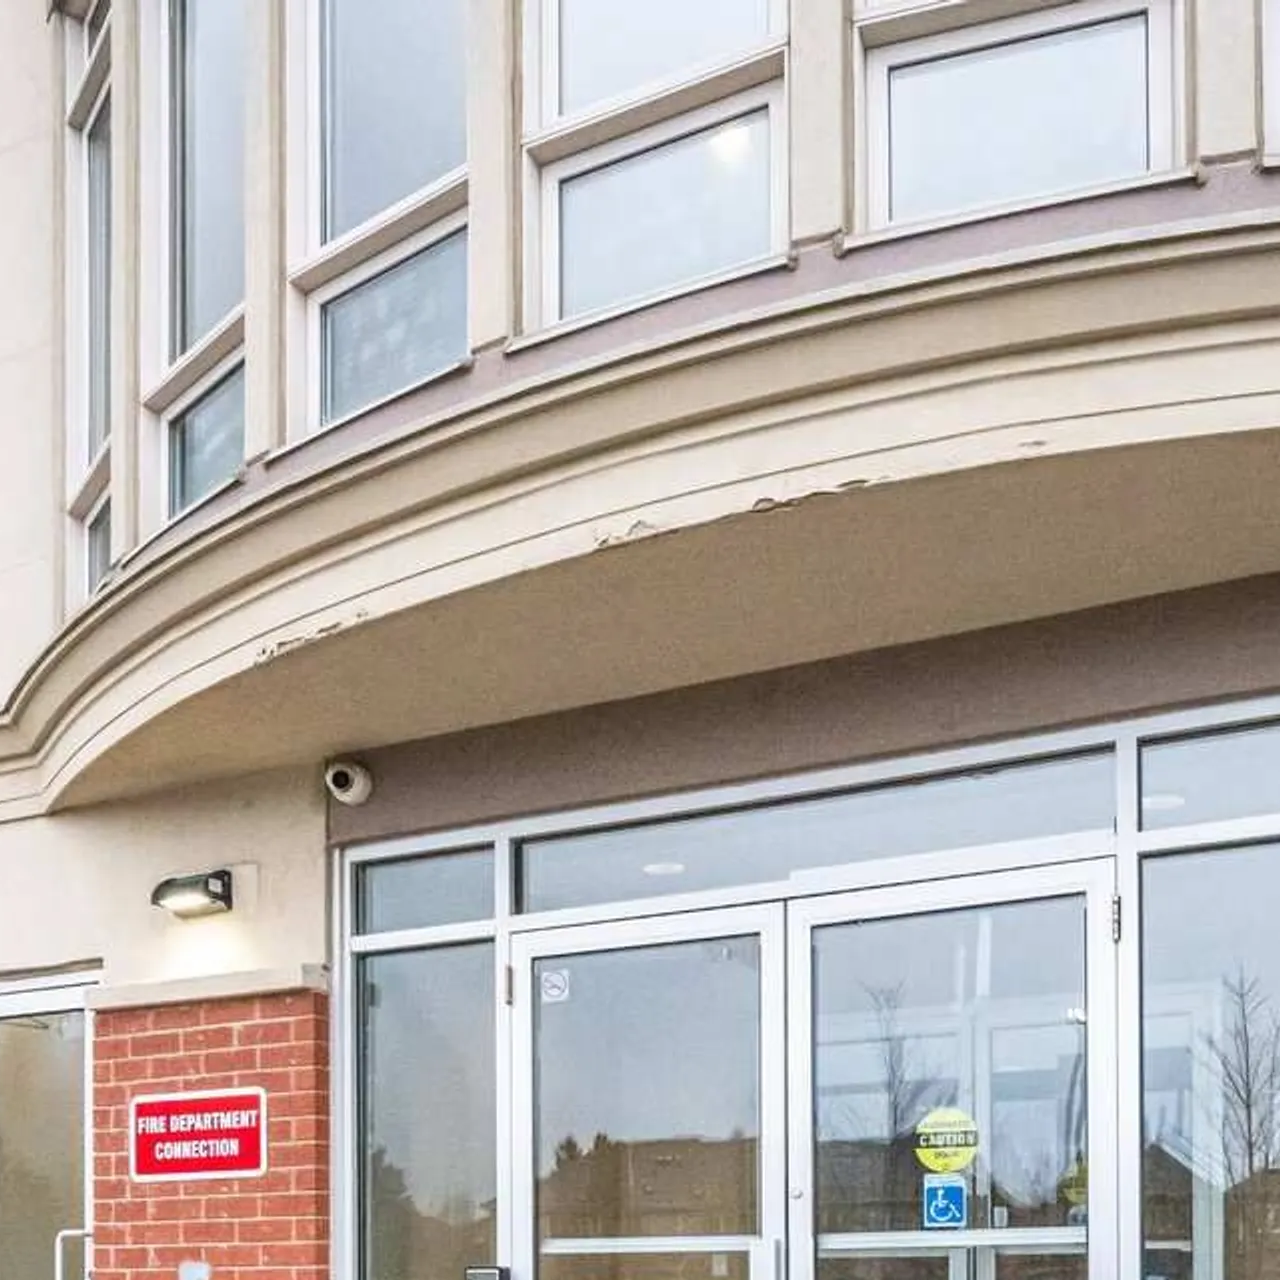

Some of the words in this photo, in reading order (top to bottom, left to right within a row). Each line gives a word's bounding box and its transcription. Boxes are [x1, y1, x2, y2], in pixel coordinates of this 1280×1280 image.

[137, 1115, 167, 1134] FIRE
[169, 1110, 258, 1132] DEPARTMENT
[155, 1139, 240, 1160] CONNECTION
